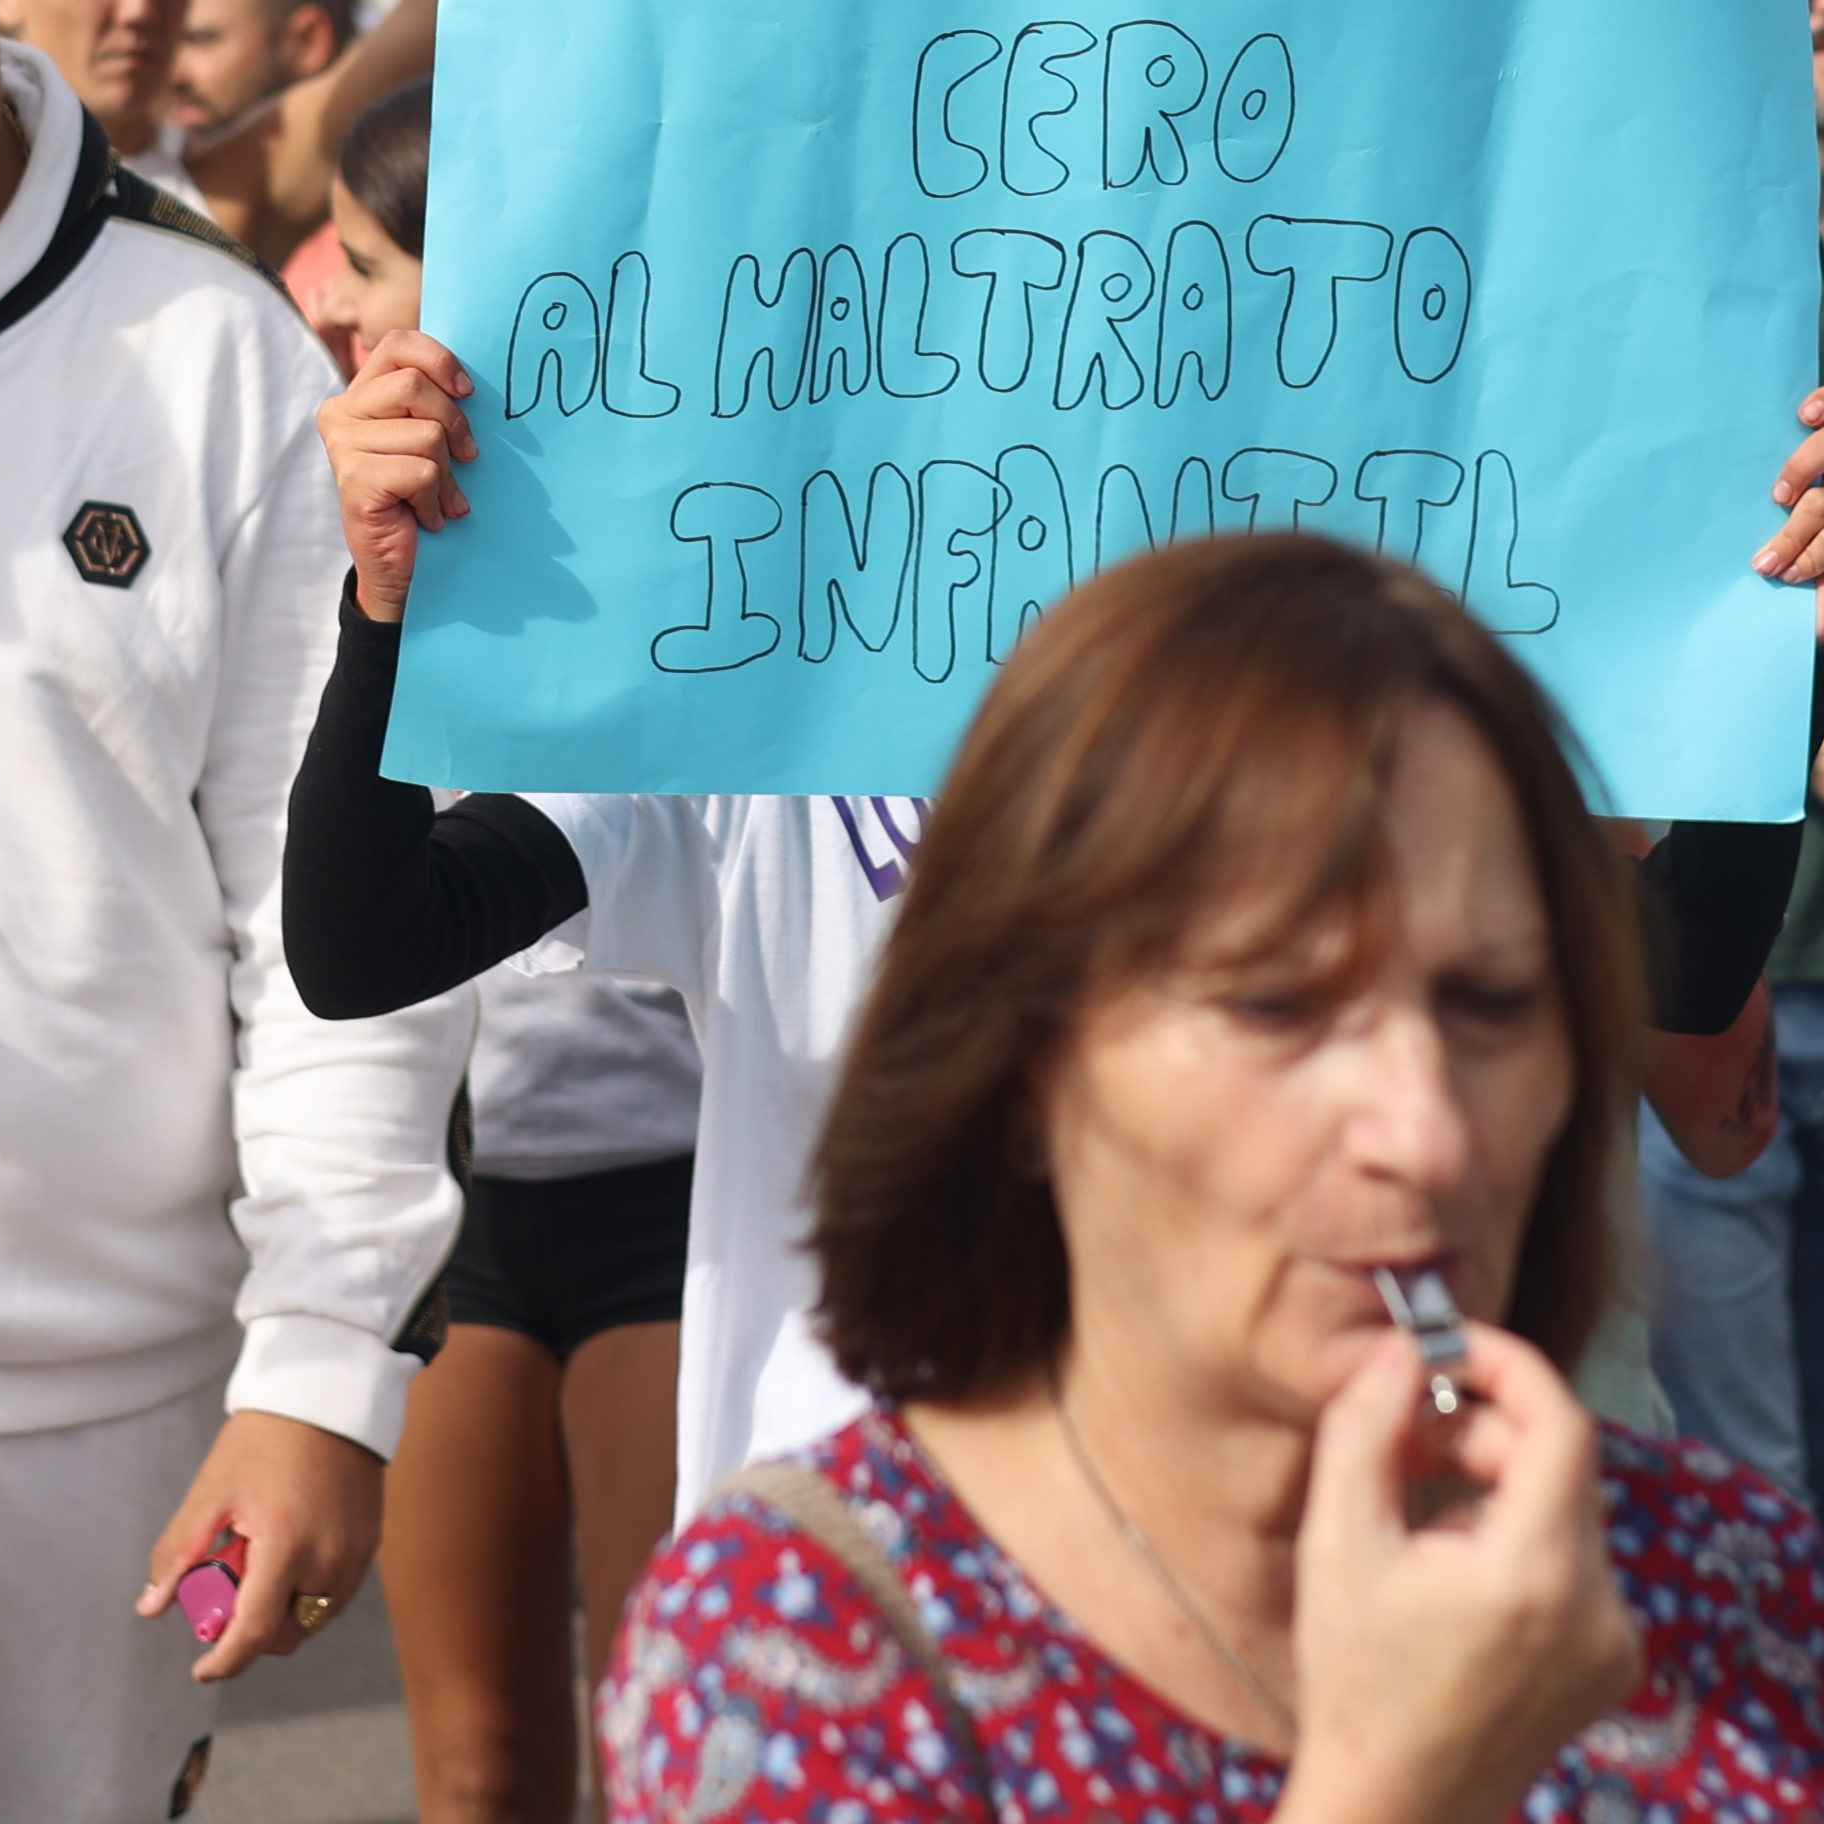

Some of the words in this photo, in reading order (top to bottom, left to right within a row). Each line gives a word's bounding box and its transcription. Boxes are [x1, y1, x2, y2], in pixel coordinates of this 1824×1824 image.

[912, 19, 1296, 198] CERO
[503, 250, 682, 422] AL
[710, 213, 1473, 419] MALTRATO
